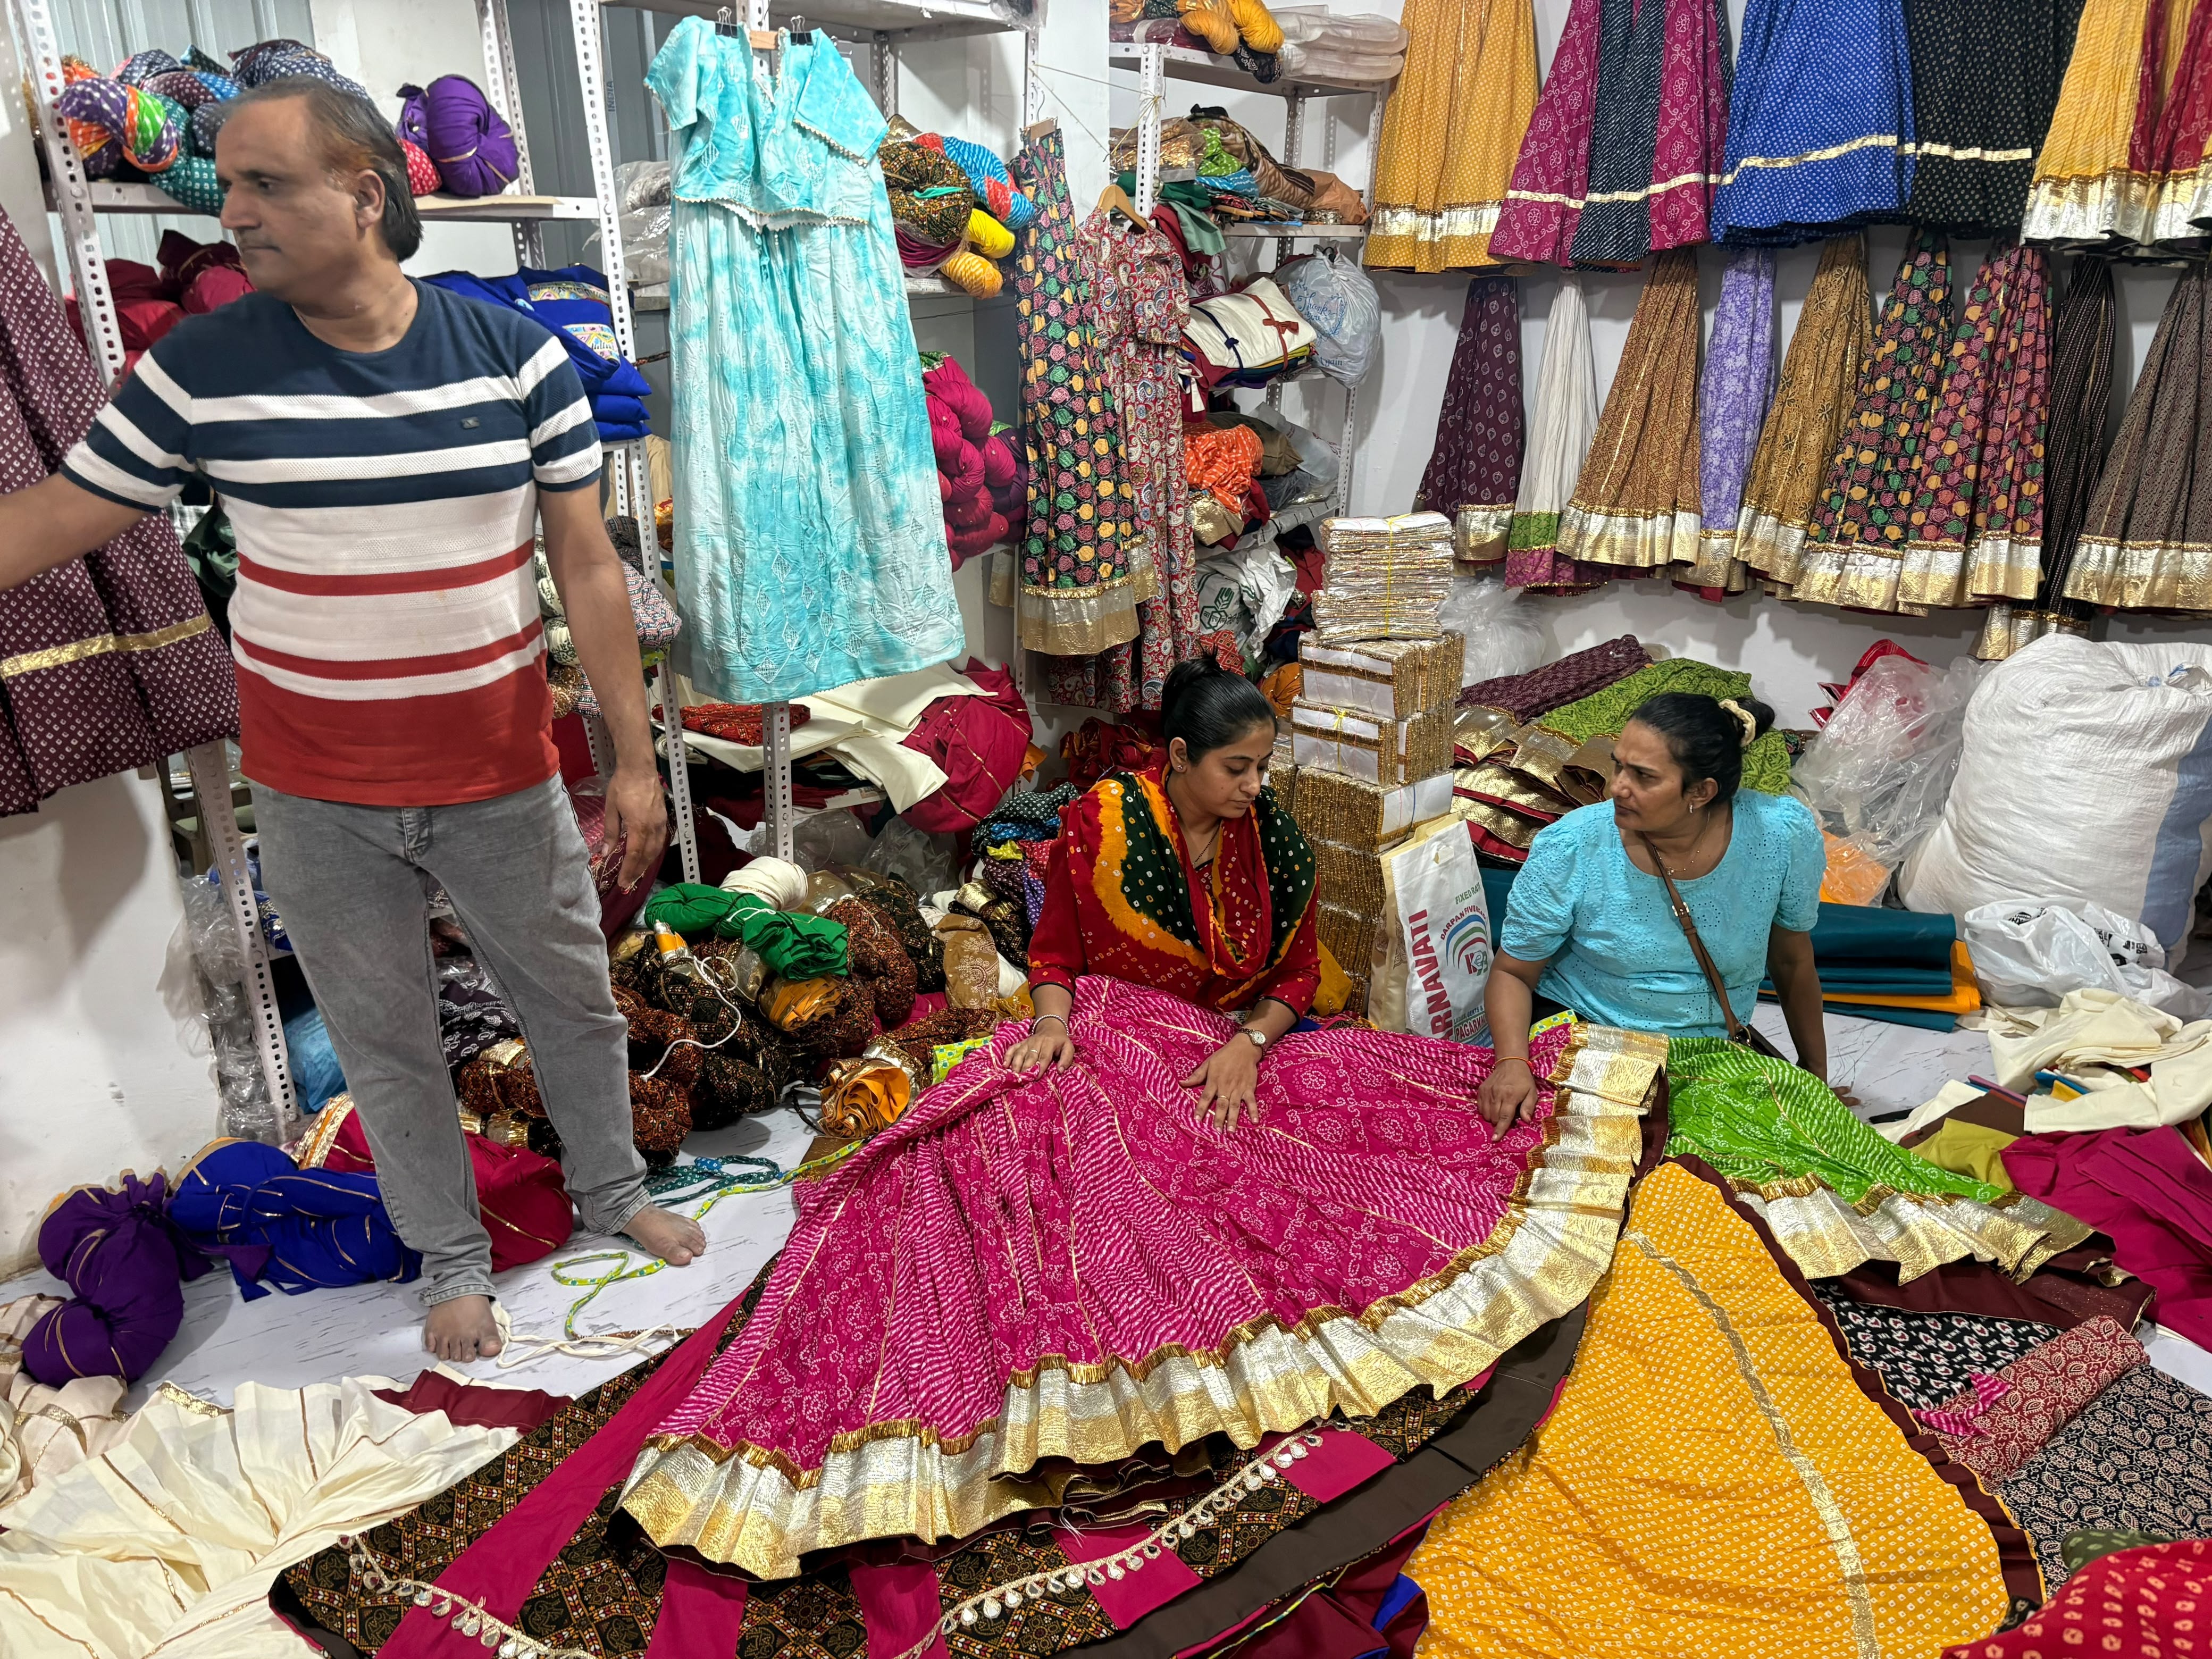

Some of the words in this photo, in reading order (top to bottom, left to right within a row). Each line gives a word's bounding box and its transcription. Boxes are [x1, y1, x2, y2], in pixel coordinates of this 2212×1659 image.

[1455, 890, 1472, 904] FIXED
[1440, 911, 1464, 940] DARPAN
[1464, 905, 1476, 915] FIVE
[1409, 909, 1453, 1041] ARNAVATI
